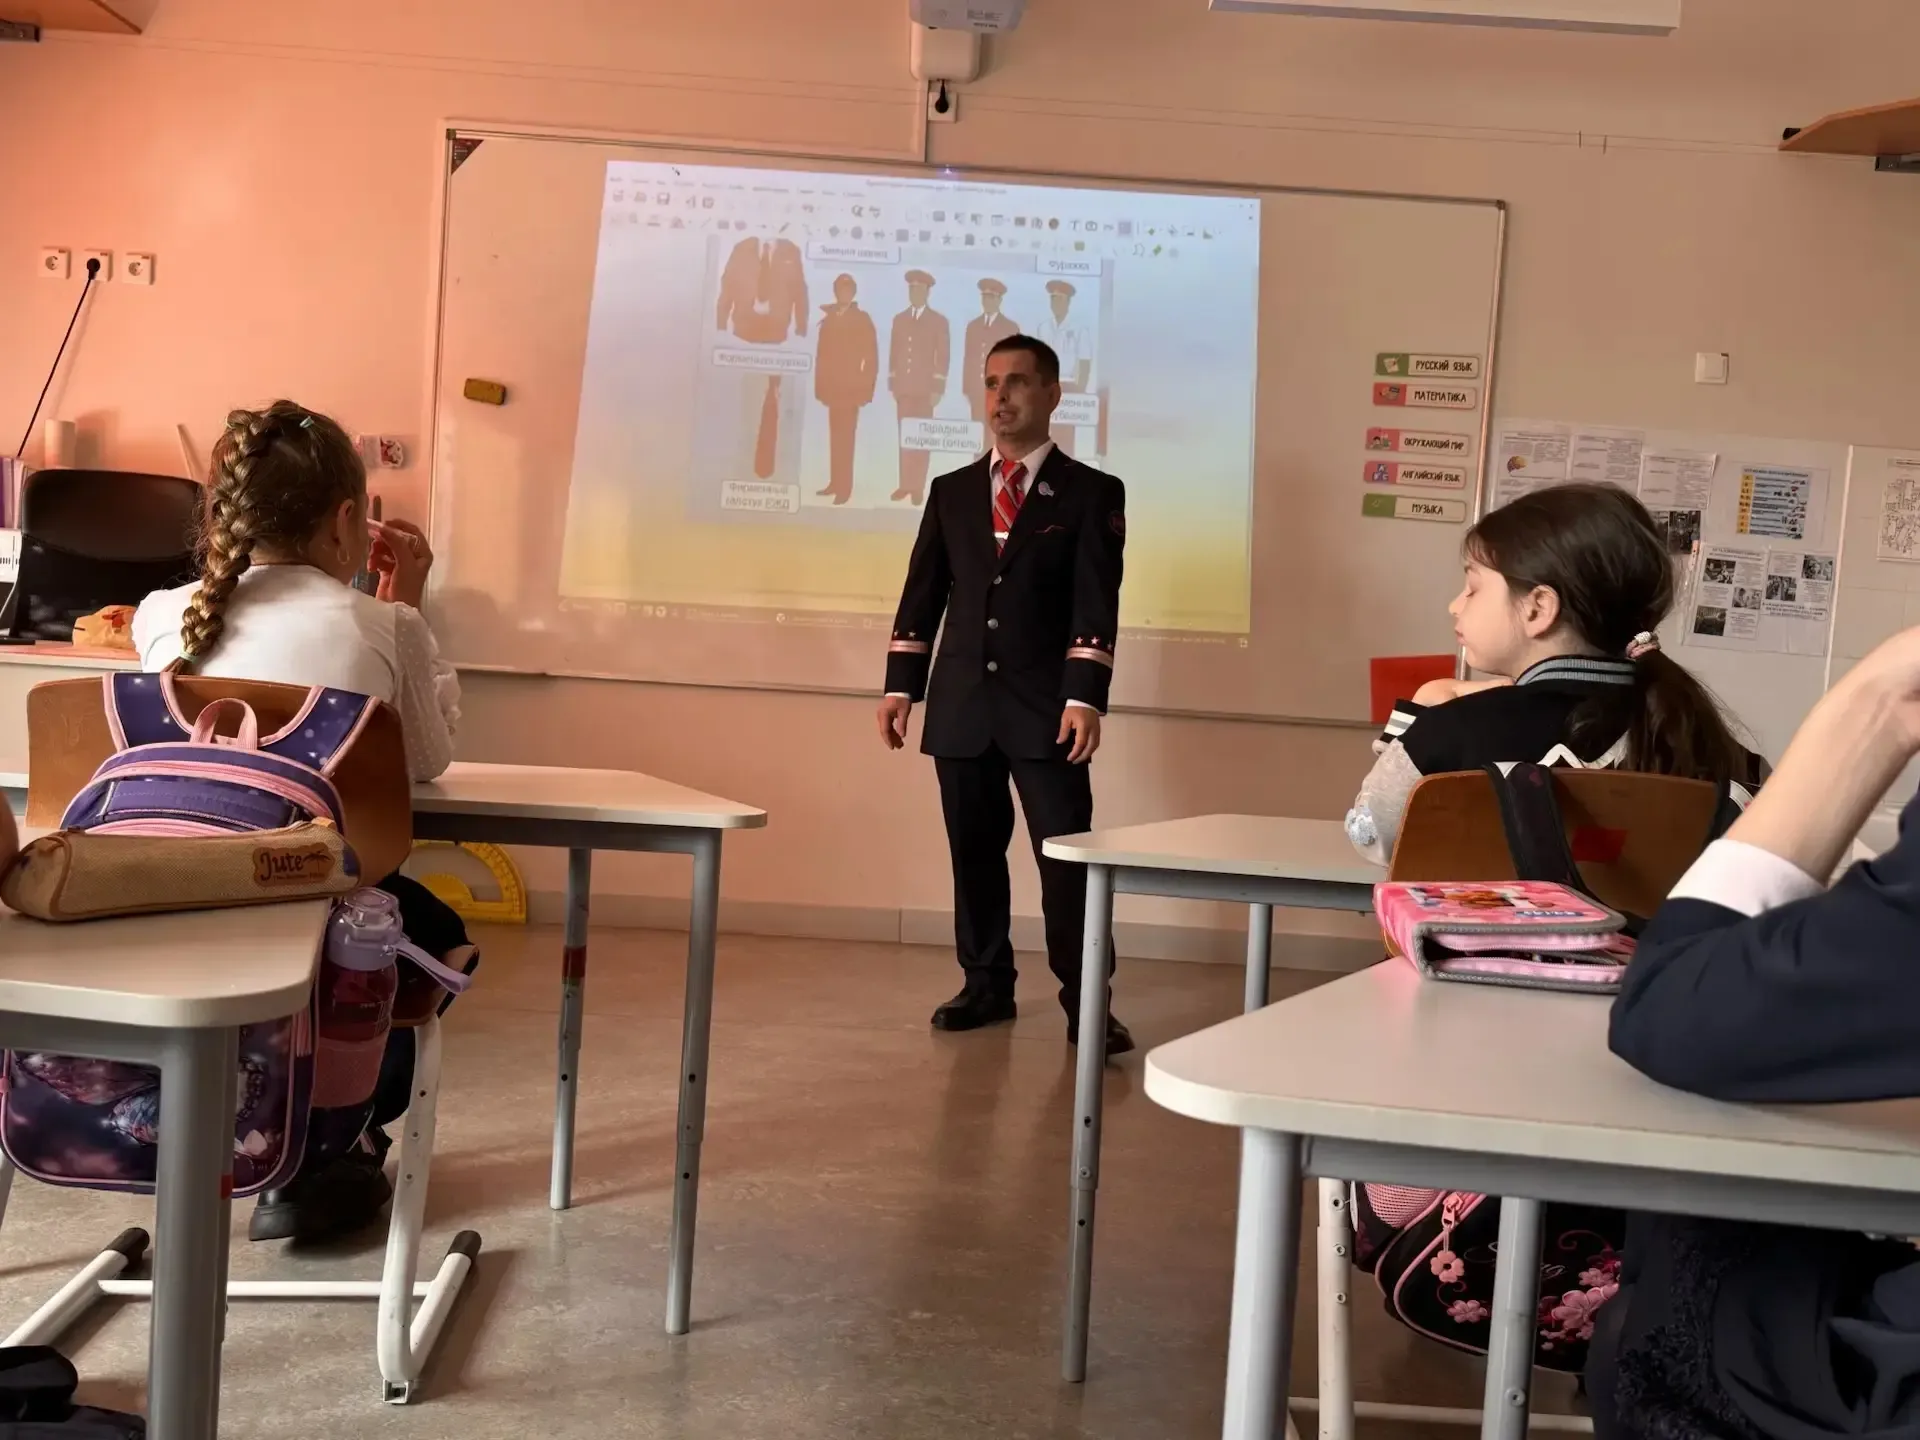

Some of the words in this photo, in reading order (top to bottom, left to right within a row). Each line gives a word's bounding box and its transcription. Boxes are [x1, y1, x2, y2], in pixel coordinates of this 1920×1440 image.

[1415, 360, 1449, 371] РУССКИЙ
[1453, 361, 1473, 372] ЯЗЫК
[1414, 390, 1467, 403] МАТЕМАТИКА
[919, 422, 968, 435] Парадный
[1404, 437, 1450, 449] ОКРУЖАЮЩИЙ
[1450, 440, 1464, 451] МИР
[1402, 470, 1443, 481] АНГЛИЙСКИЙ
[1443, 473, 1460, 483] ЯЗЫК
[729, 482, 789, 494] Фирменный
[1411, 503, 1444, 516] МУЗЫКА
[260, 852, 304, 881] Jute
